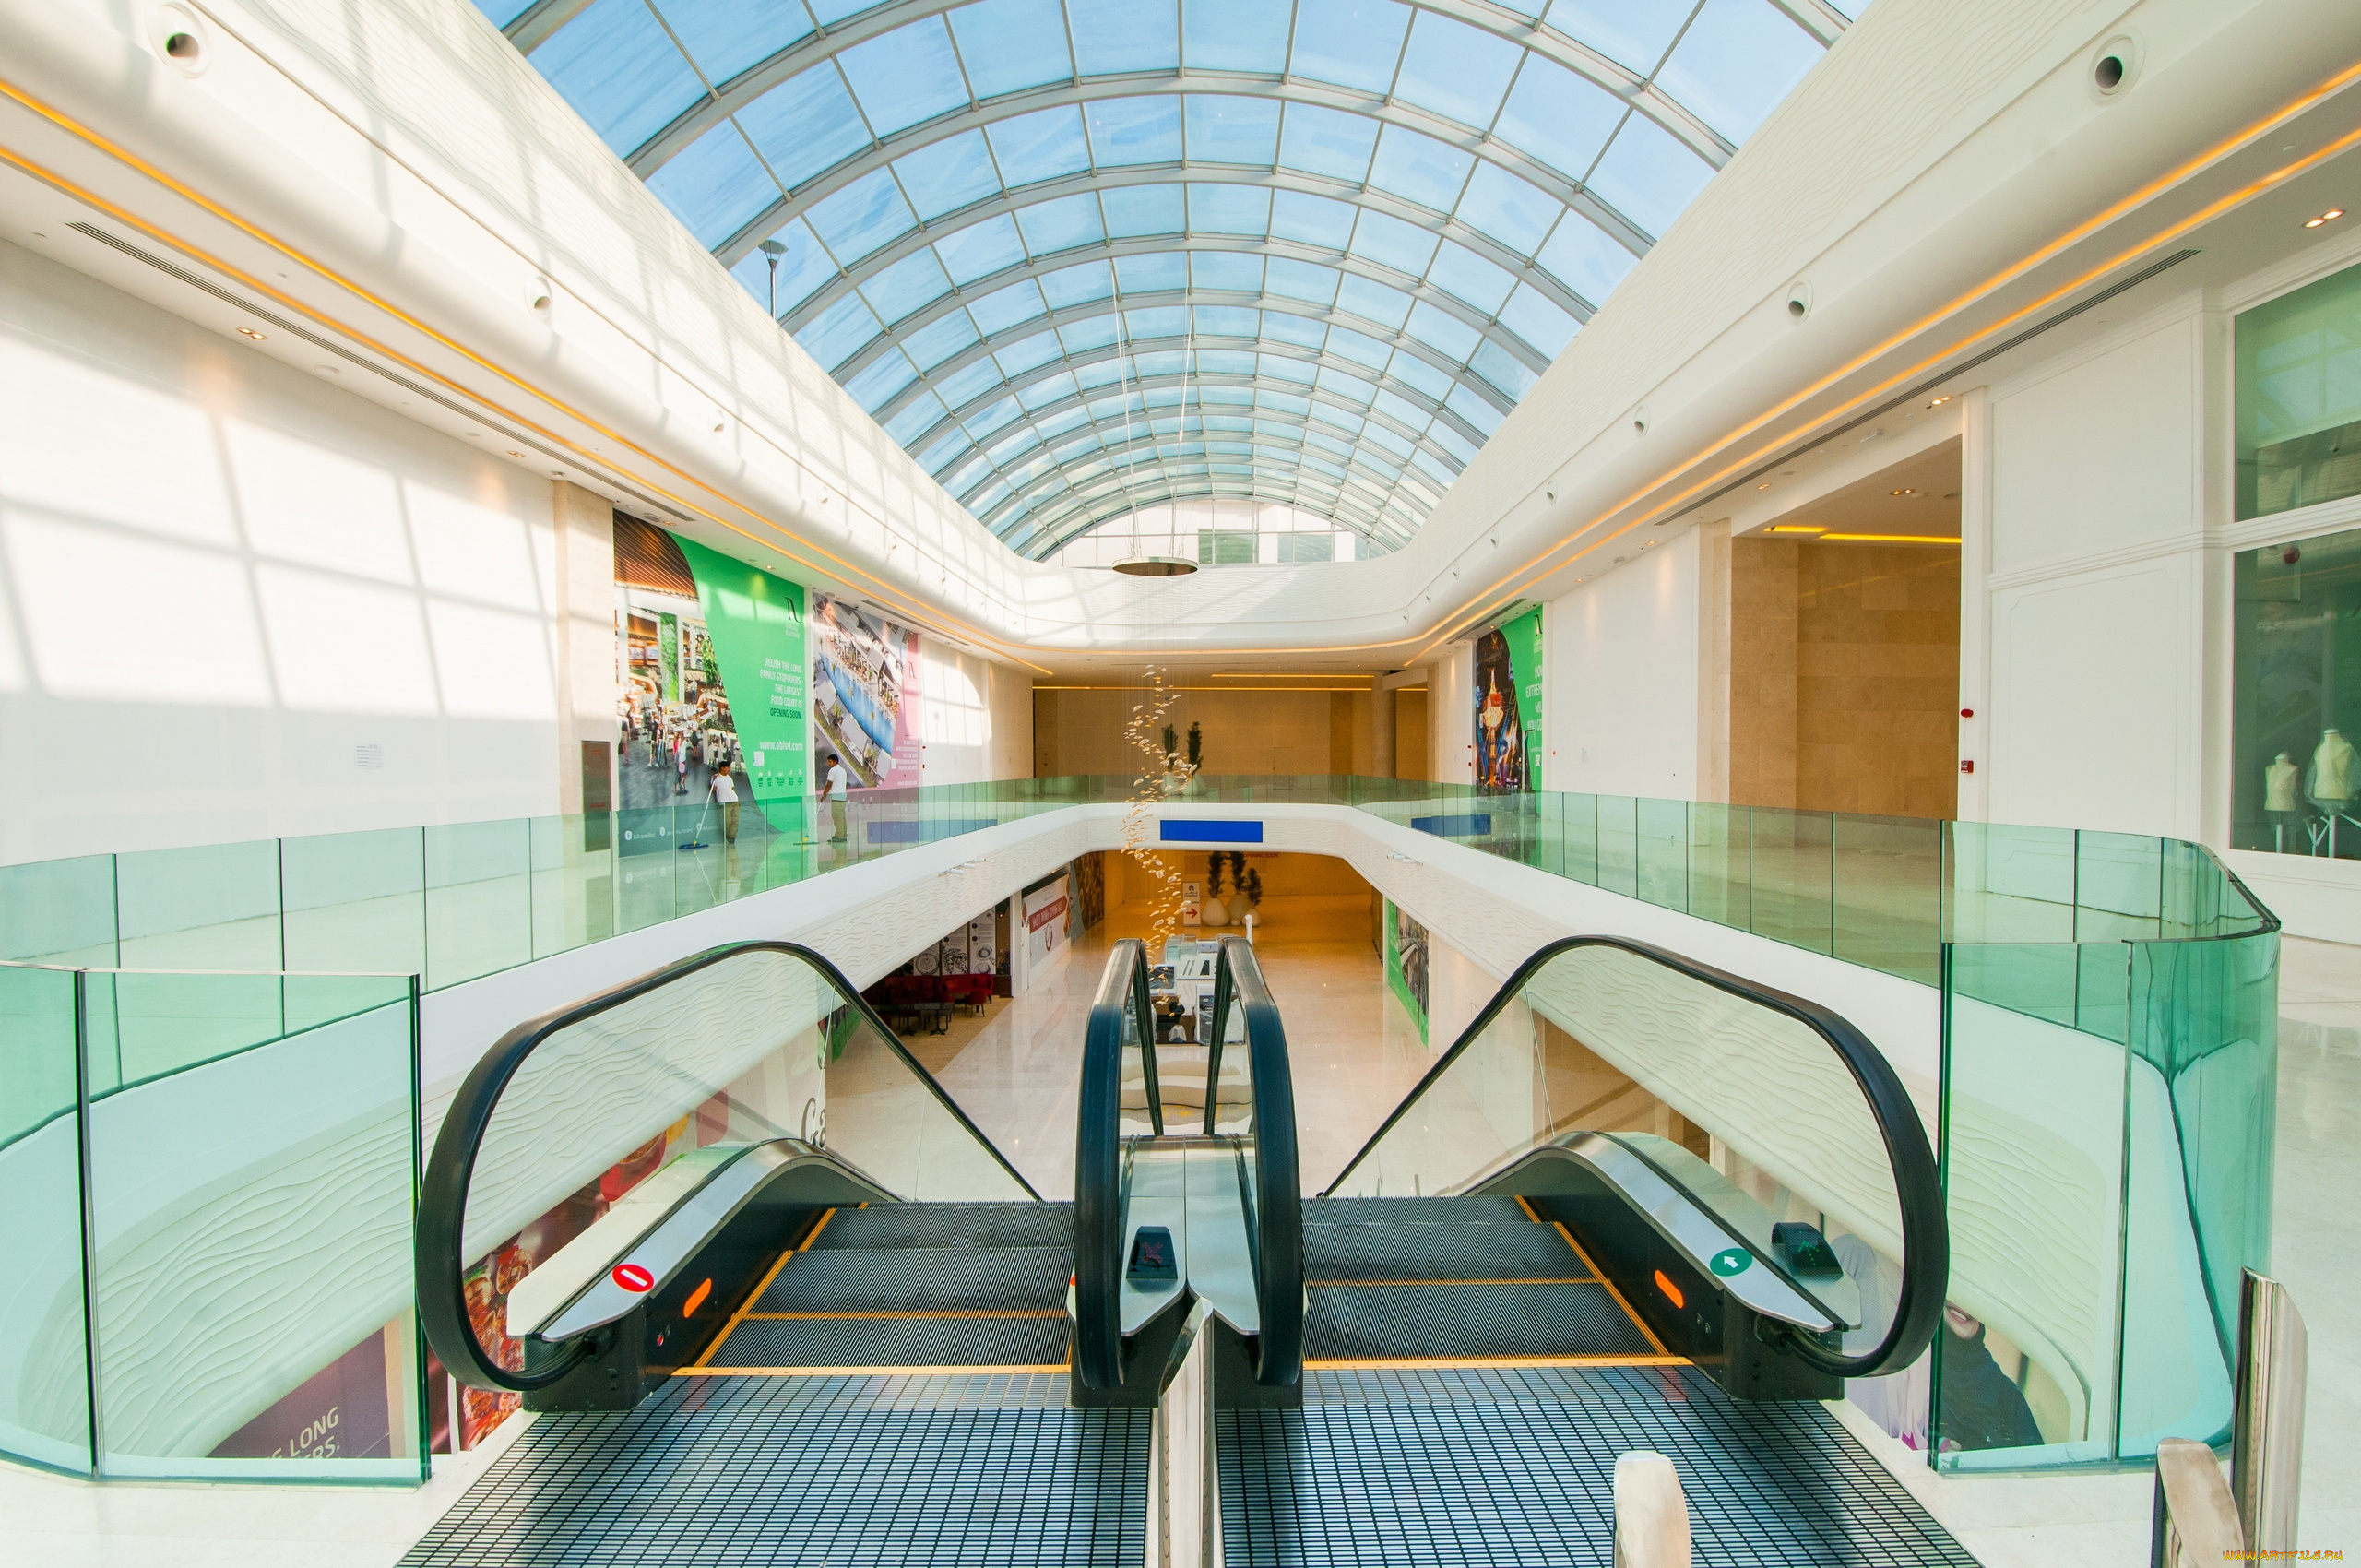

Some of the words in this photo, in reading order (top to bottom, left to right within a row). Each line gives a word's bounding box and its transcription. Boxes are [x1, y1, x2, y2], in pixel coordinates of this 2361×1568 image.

[765, 658, 781, 669] RELISH
[782, 662, 790, 671] THE
[791, 664, 802, 673] LONG
[759, 669, 776, 680] FAMILY
[775, 684, 783, 693] THE
[784, 686, 802, 696] LARGEST
[771, 695, 783, 705] FOOD
[783, 698, 797, 707] COURT
[798, 700, 802, 708] IS
[770, 707, 789, 718] OPENING
[759, 740, 803, 751] www.ablvd.com
[289, 1406, 338, 1458] LONG
